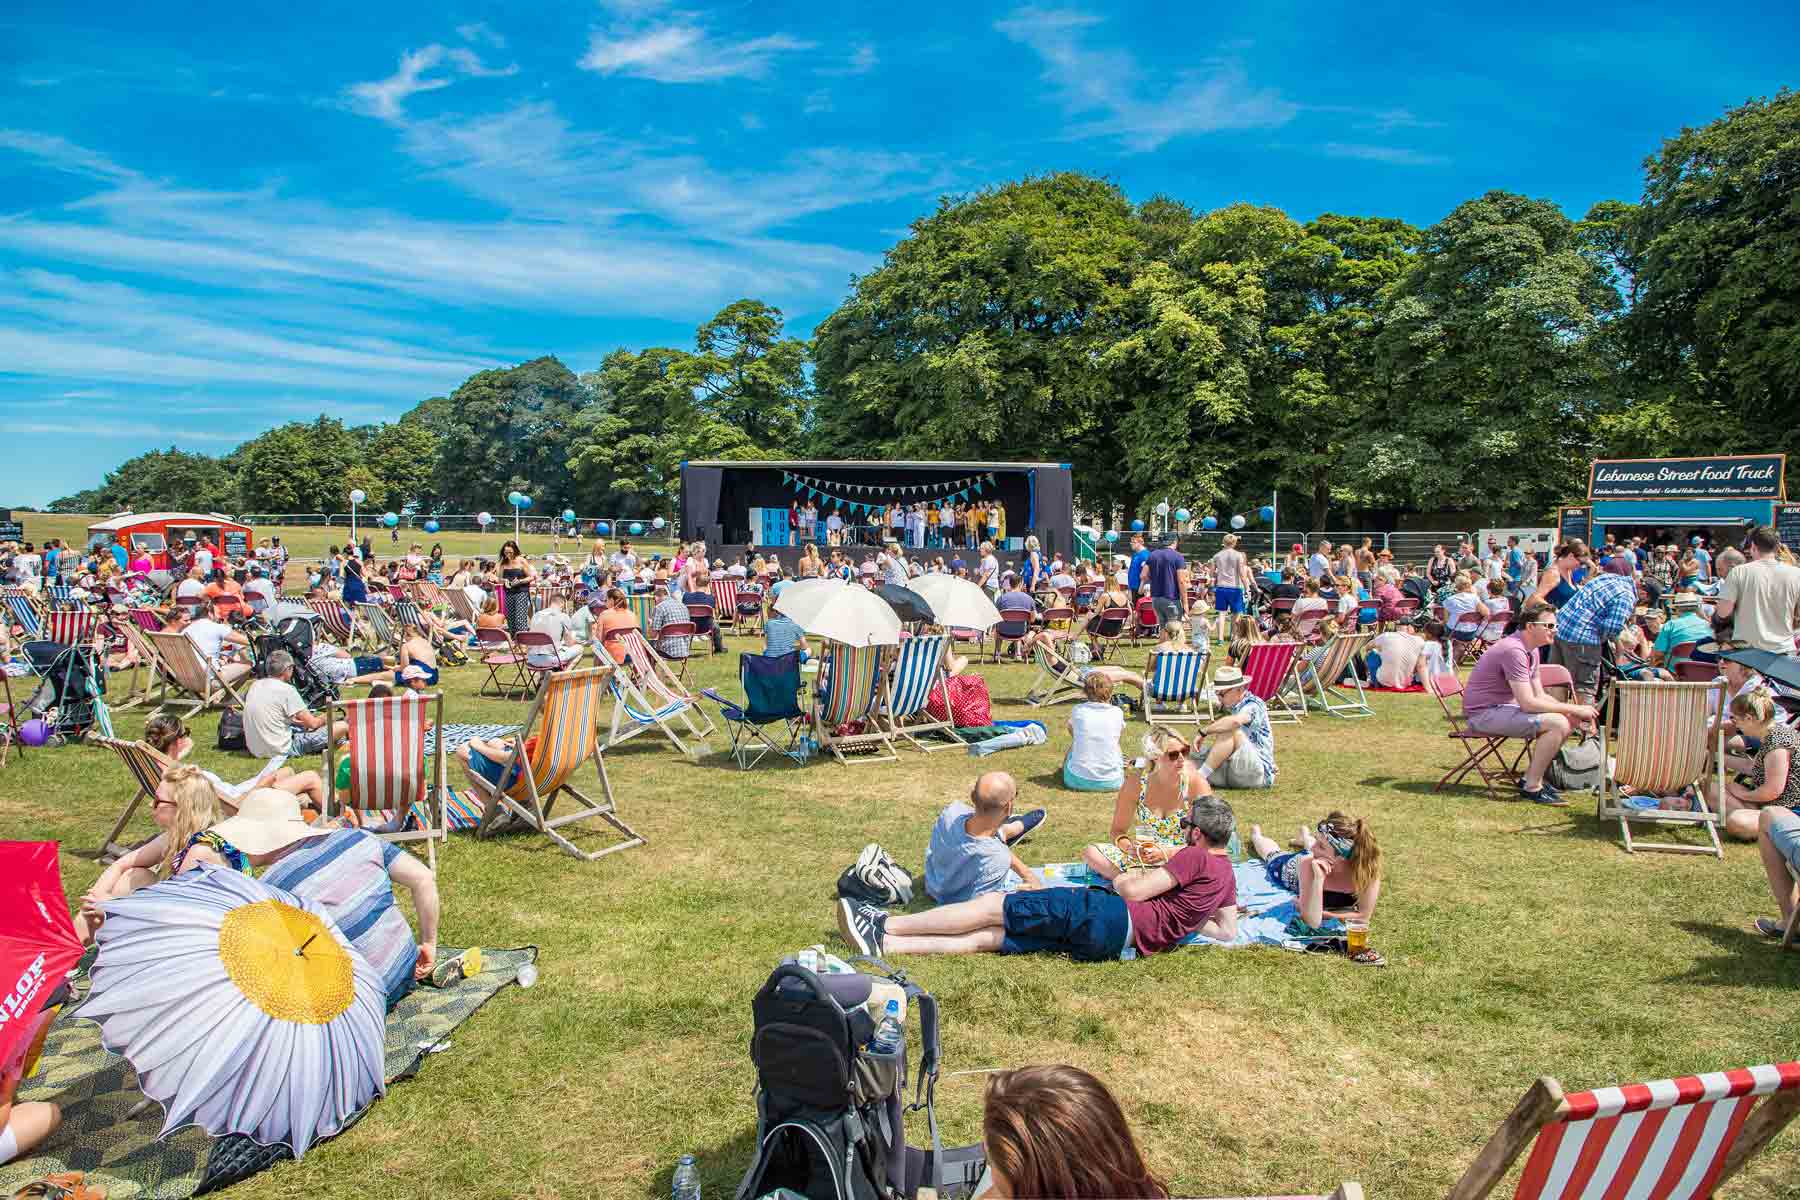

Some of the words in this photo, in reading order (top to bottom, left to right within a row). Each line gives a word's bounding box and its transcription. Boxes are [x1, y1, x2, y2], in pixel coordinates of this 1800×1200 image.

[1597, 467, 1655, 482] Lebanese
[1657, 466, 1700, 481] Street
[1737, 464, 1775, 479] Truck
[14, 971, 48, 1019] SPORT
